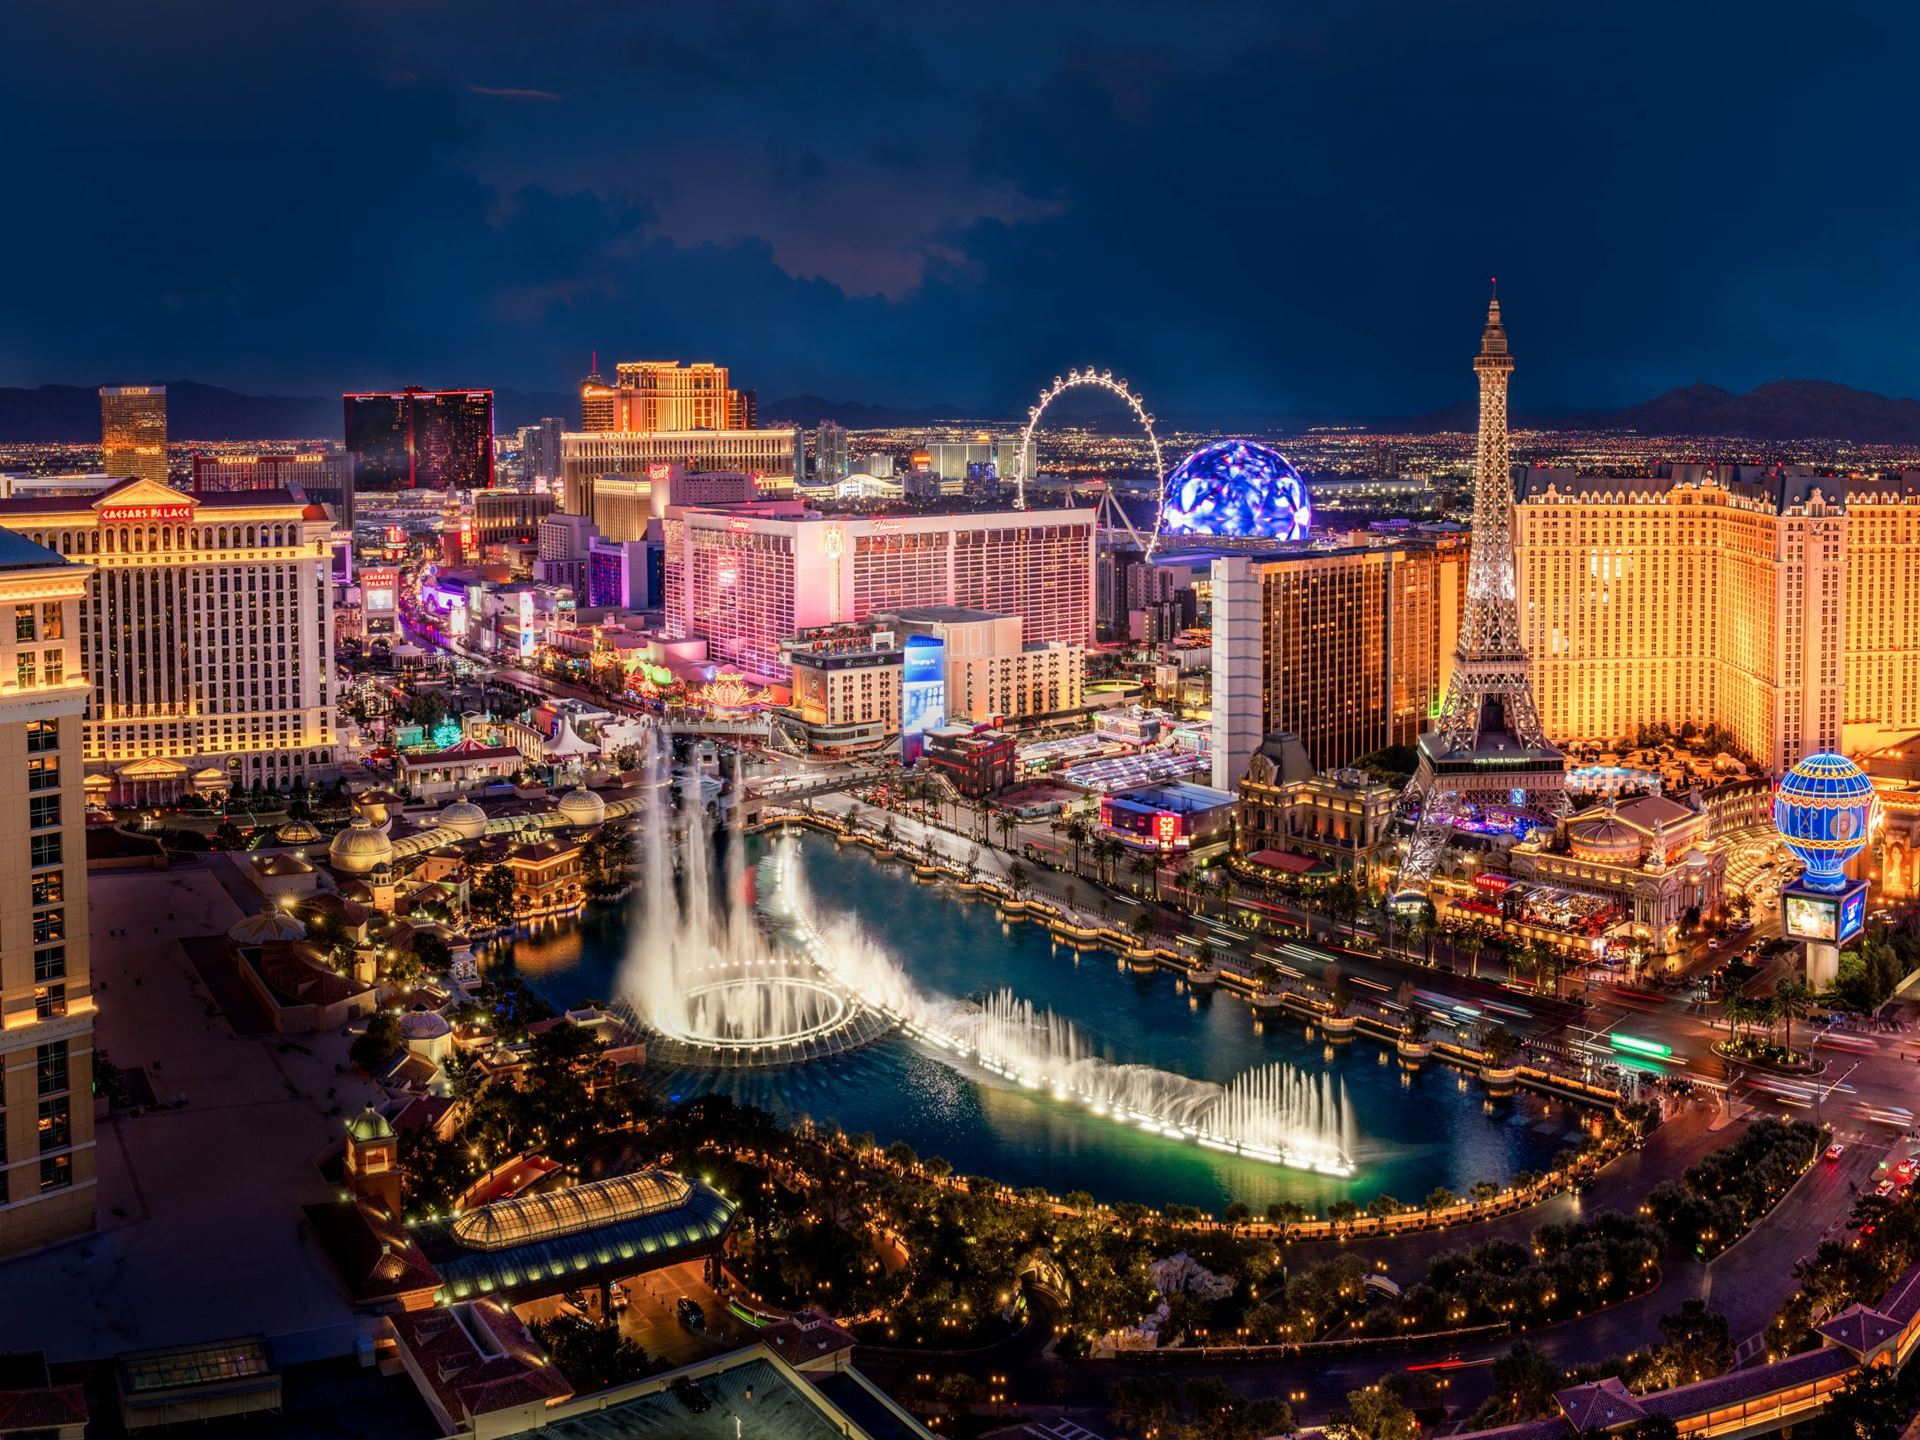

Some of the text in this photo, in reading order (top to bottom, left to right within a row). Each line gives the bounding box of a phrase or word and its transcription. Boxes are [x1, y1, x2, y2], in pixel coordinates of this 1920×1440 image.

[121, 387, 150, 395] TRUMP
[603, 432, 650, 440] VENETIAN
[102, 508, 190, 519] CAESARS PALACE
[1476, 877, 1506, 888] BEER PARK
